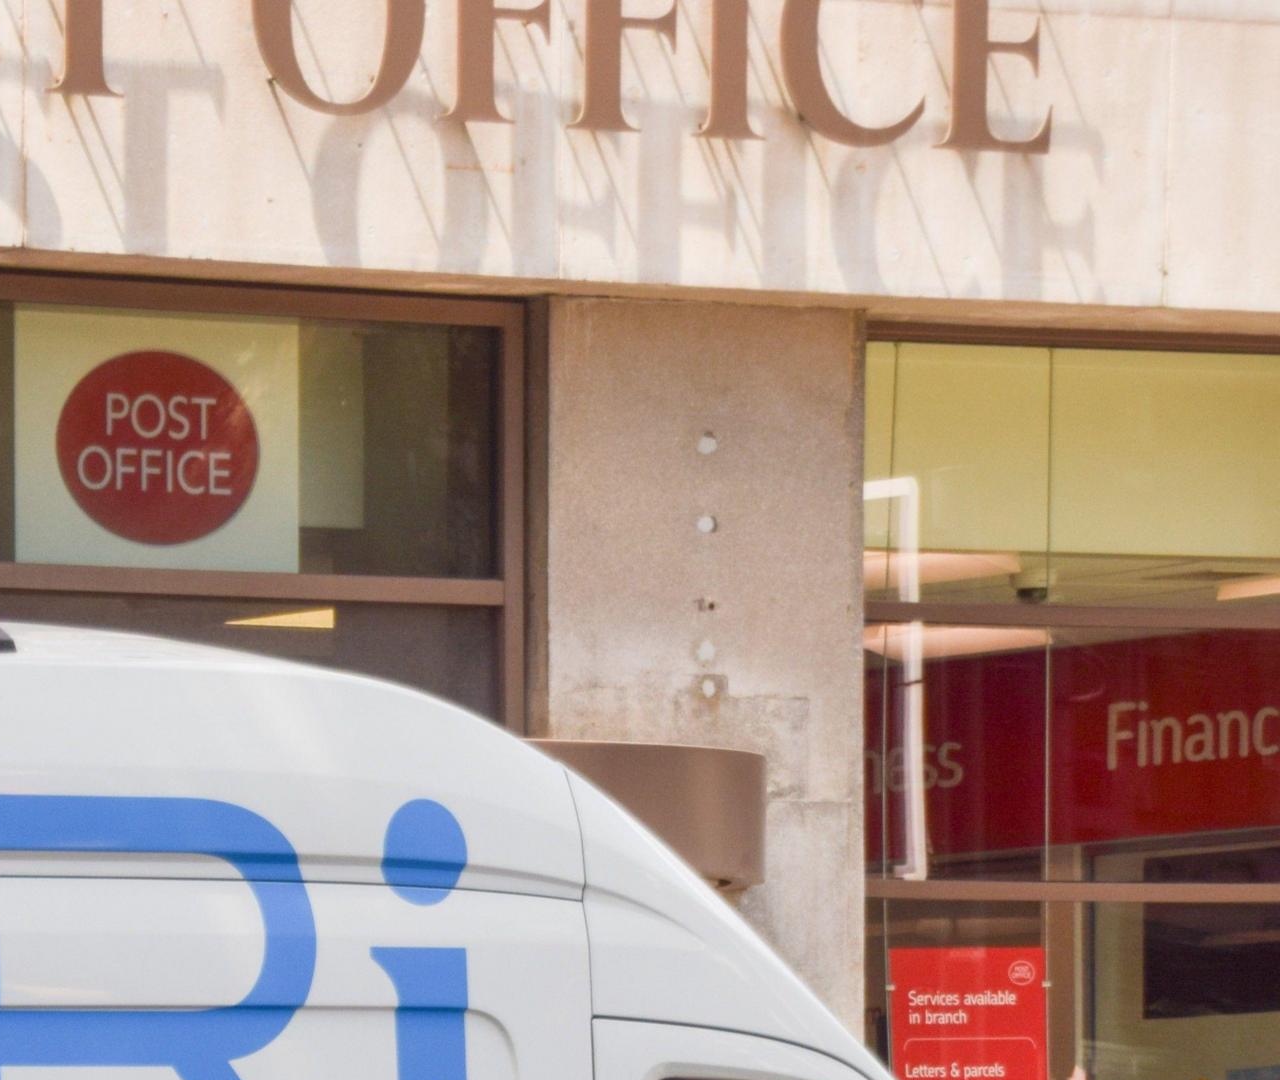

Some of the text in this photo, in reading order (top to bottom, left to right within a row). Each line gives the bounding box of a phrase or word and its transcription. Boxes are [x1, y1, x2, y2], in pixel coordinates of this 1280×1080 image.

[253, 0, 1053, 155] OFFICE
[106, 393, 216, 440] POST
[77, 446, 232, 495] OFFICE
[1107, 701, 1280, 771] Financ
[908, 990, 1017, 1006] Services available
[909, 1010, 967, 1024] in branch
[905, 1063, 1006, 1080] Letters & parcels
